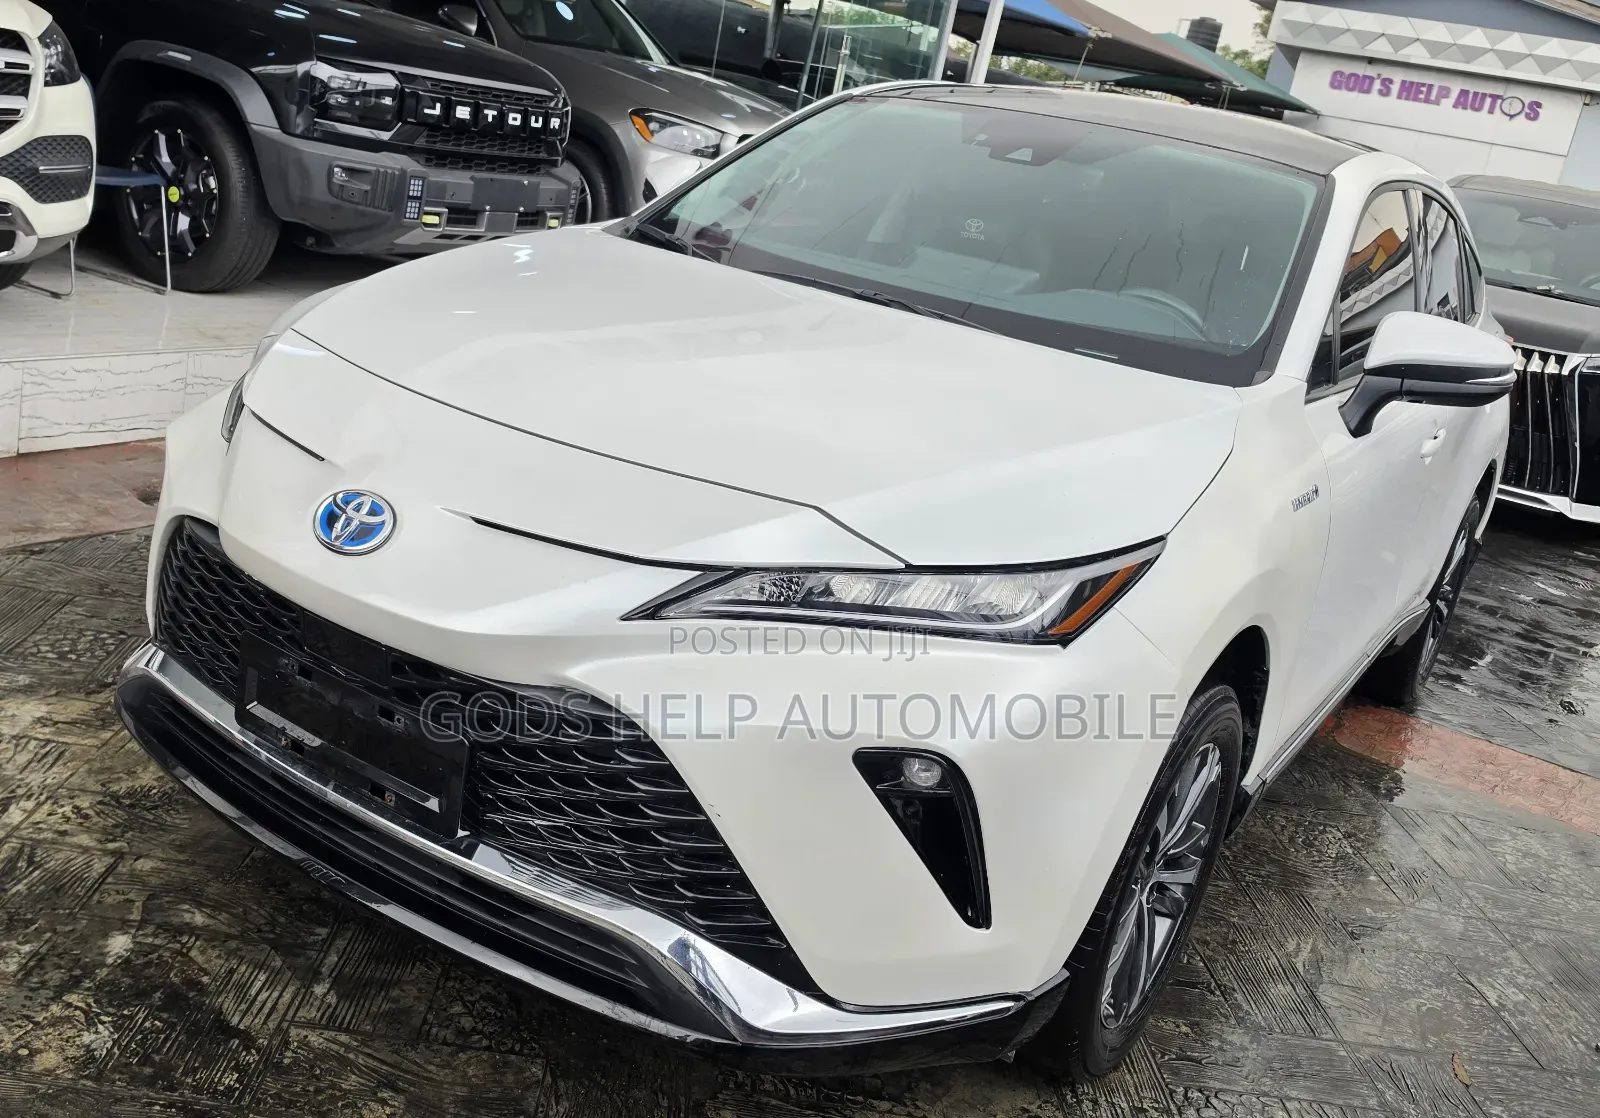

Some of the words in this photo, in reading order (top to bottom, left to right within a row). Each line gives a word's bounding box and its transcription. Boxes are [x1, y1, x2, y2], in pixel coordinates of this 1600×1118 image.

[1329, 69, 1395, 98] GOD'S
[1396, 79, 1452, 106] HELP
[1452, 88, 1543, 122] AUTOS
[423, 102, 561, 130] JETOUR
[960, 231, 985, 241] TOYOTA
